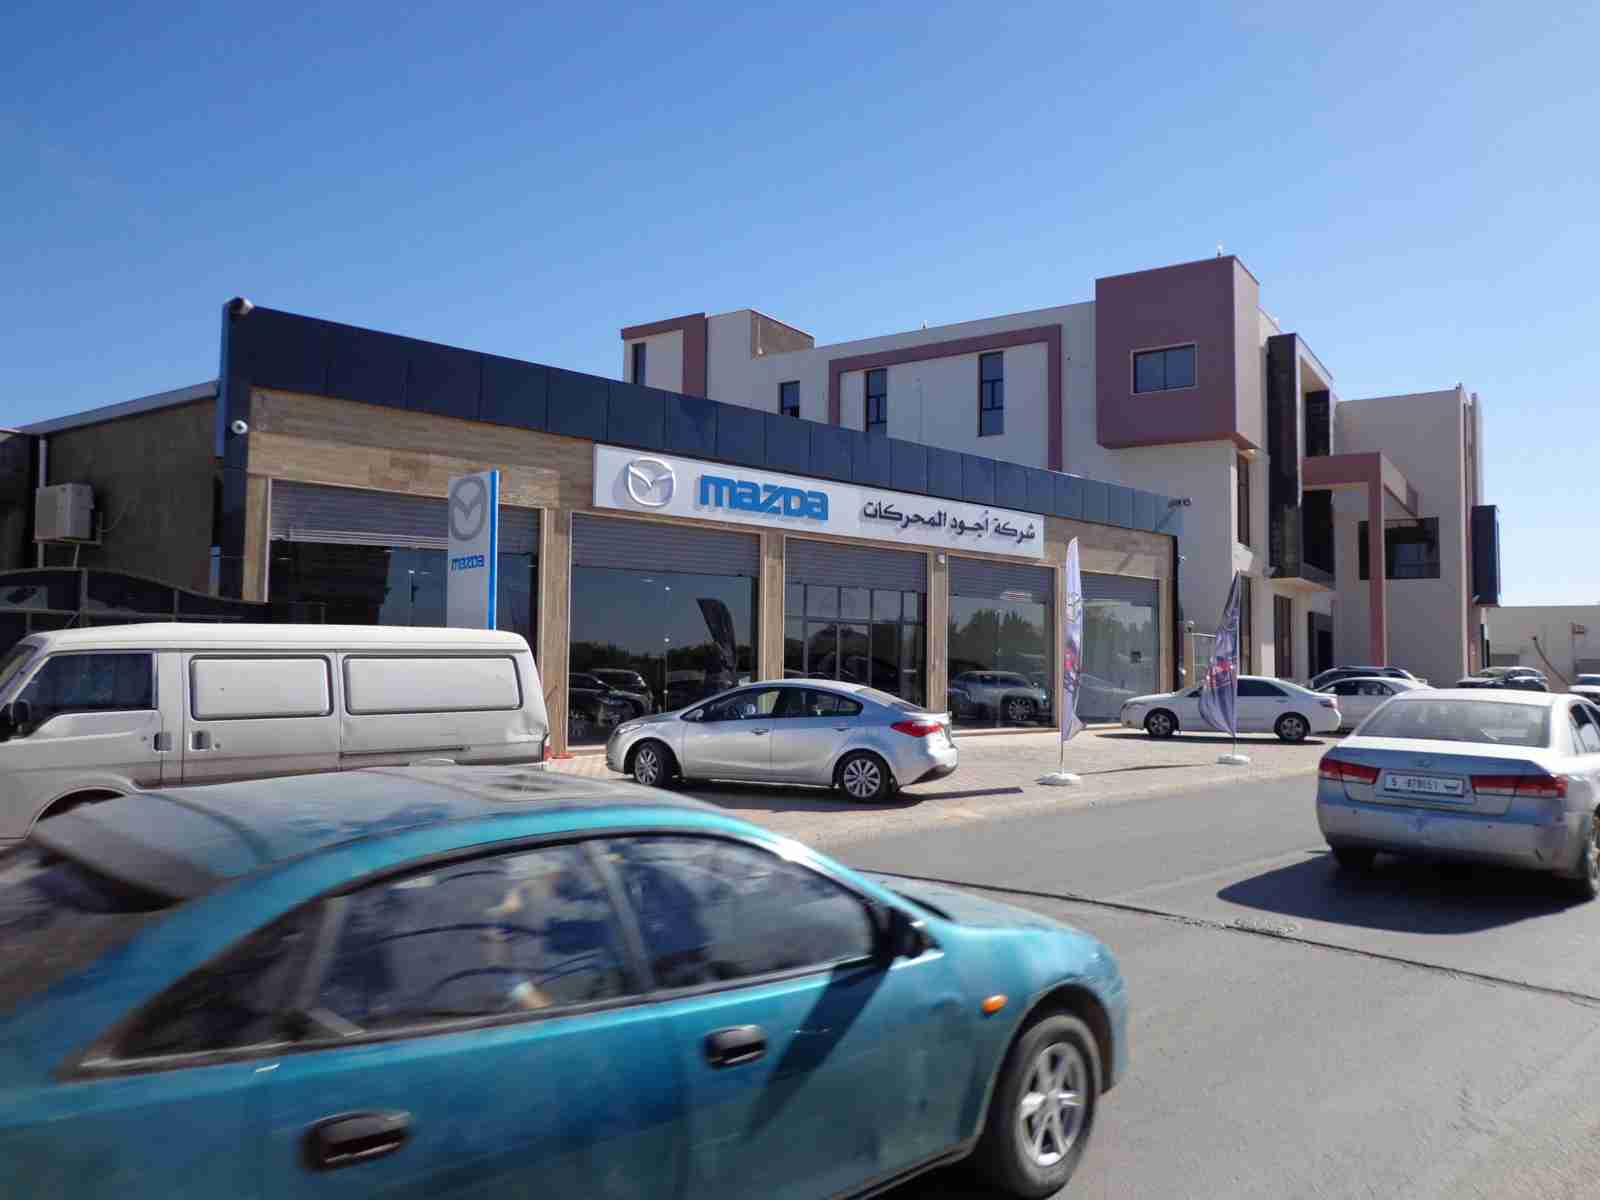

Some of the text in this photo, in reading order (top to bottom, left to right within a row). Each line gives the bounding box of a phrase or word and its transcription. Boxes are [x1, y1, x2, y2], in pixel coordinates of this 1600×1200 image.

[700, 475, 828, 520] mazda
[863, 500, 1036, 544] شركة أجود المحركات
[451, 555, 485, 570] mazda
